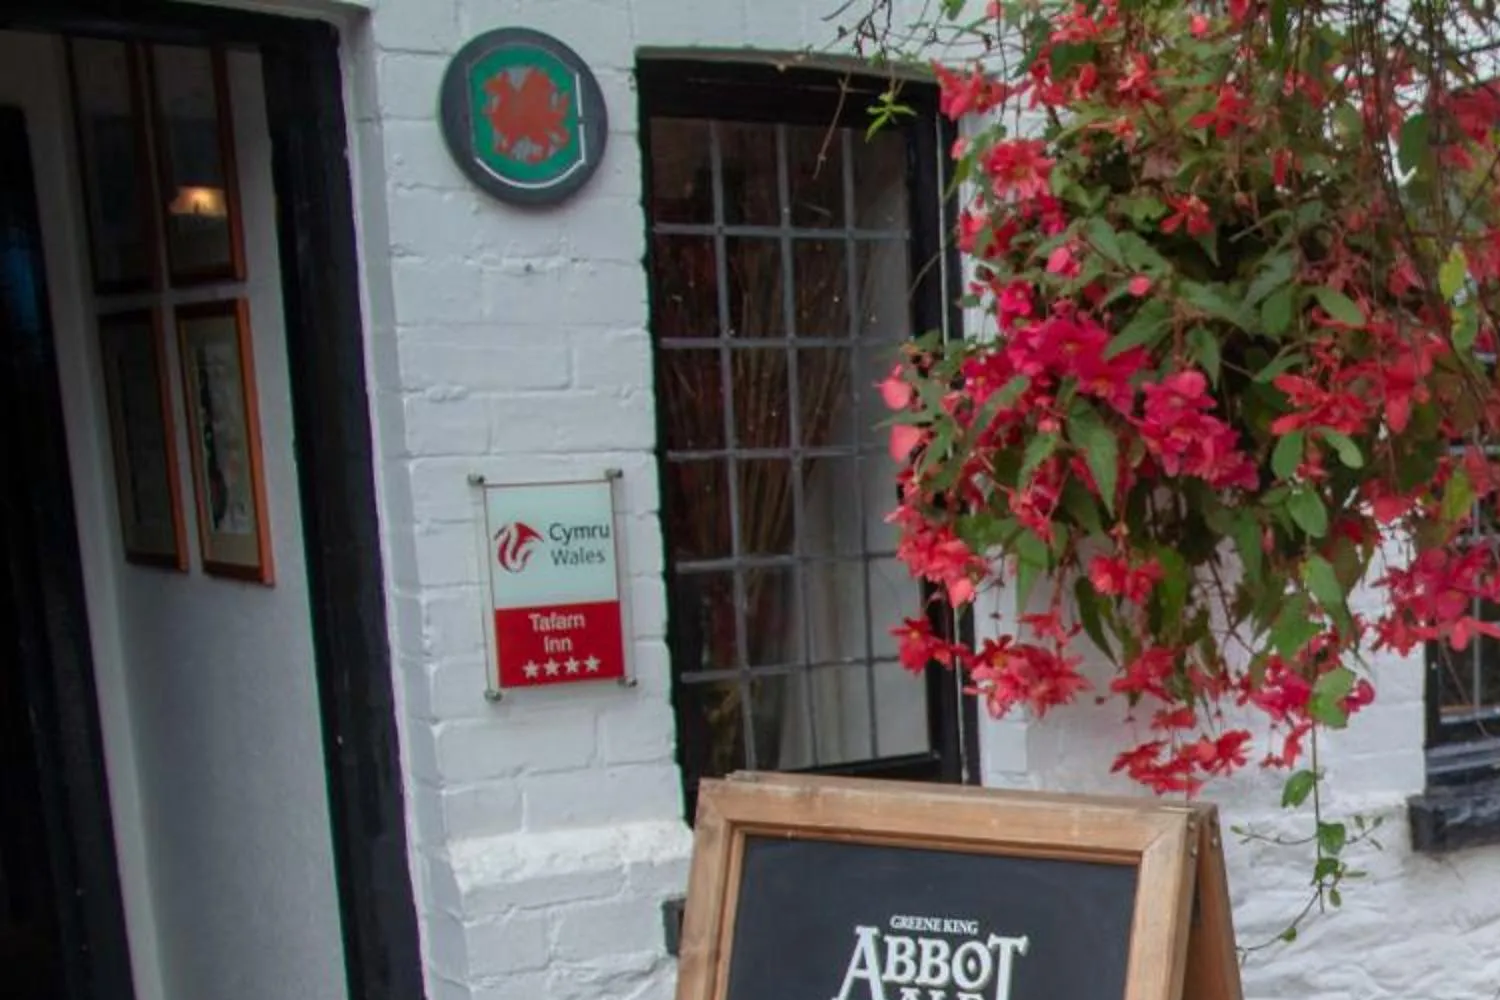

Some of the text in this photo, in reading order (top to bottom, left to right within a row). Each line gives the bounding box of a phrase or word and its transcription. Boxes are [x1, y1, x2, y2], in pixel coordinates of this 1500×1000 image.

[549, 522, 610, 544] Cymru
[551, 548, 606, 566] Wales
[528, 612, 586, 632] Tafarn
[544, 635, 573, 654] Inn
[889, 915, 979, 935] GREENE KING
